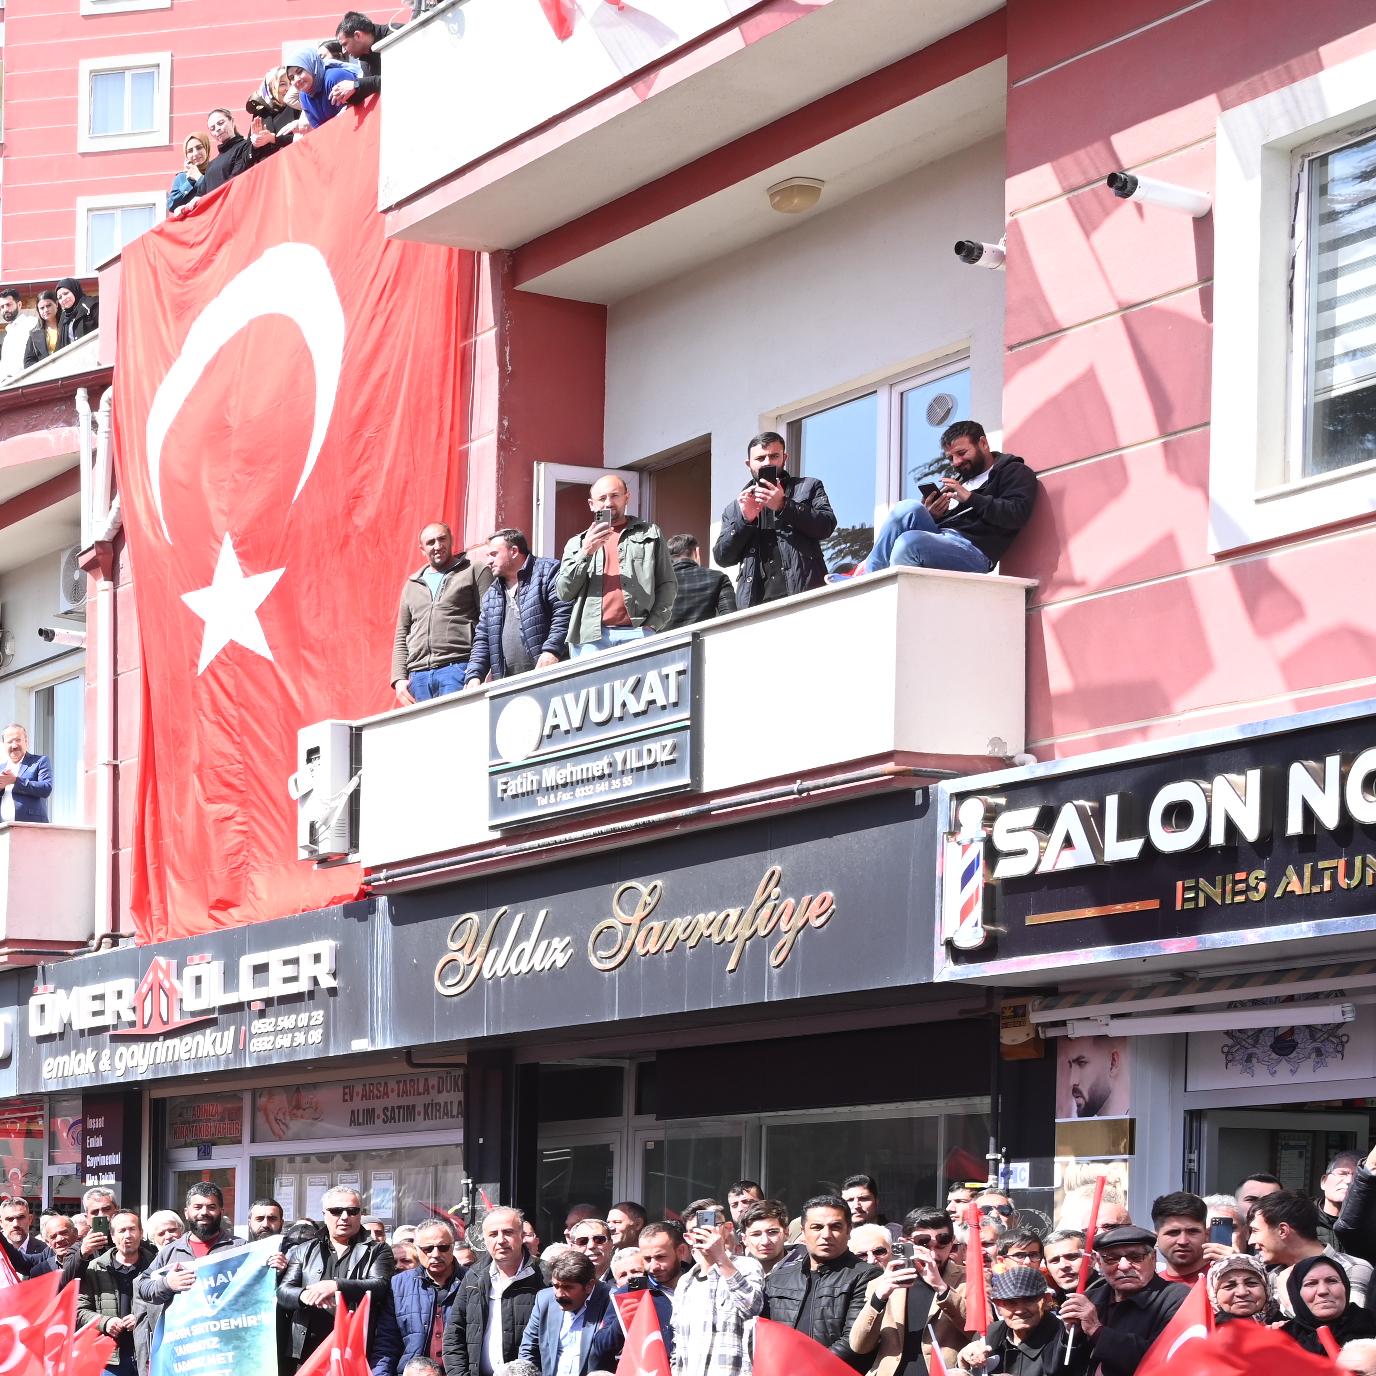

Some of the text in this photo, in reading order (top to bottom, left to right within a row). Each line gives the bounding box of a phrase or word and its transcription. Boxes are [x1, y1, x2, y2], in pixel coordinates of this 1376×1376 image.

[543, 664, 687, 739] AVUKAT
[497, 739, 677, 798] Fatih Mehmet YILDIZ
[992, 768, 1261, 880] SALON
[1175, 870, 1267, 911] ENES
[434, 866, 836, 997] Yıldız Sarrafiye
[29, 940, 338, 1038] ÖMER ÖLÇER
[42, 1026, 235, 1080] emlak & gayrimenkul
[343, 1078, 430, 1102] EV ARSA TARLA
[349, 1107, 376, 1127] ALIM
[382, 1103, 415, 1124] SATIM
